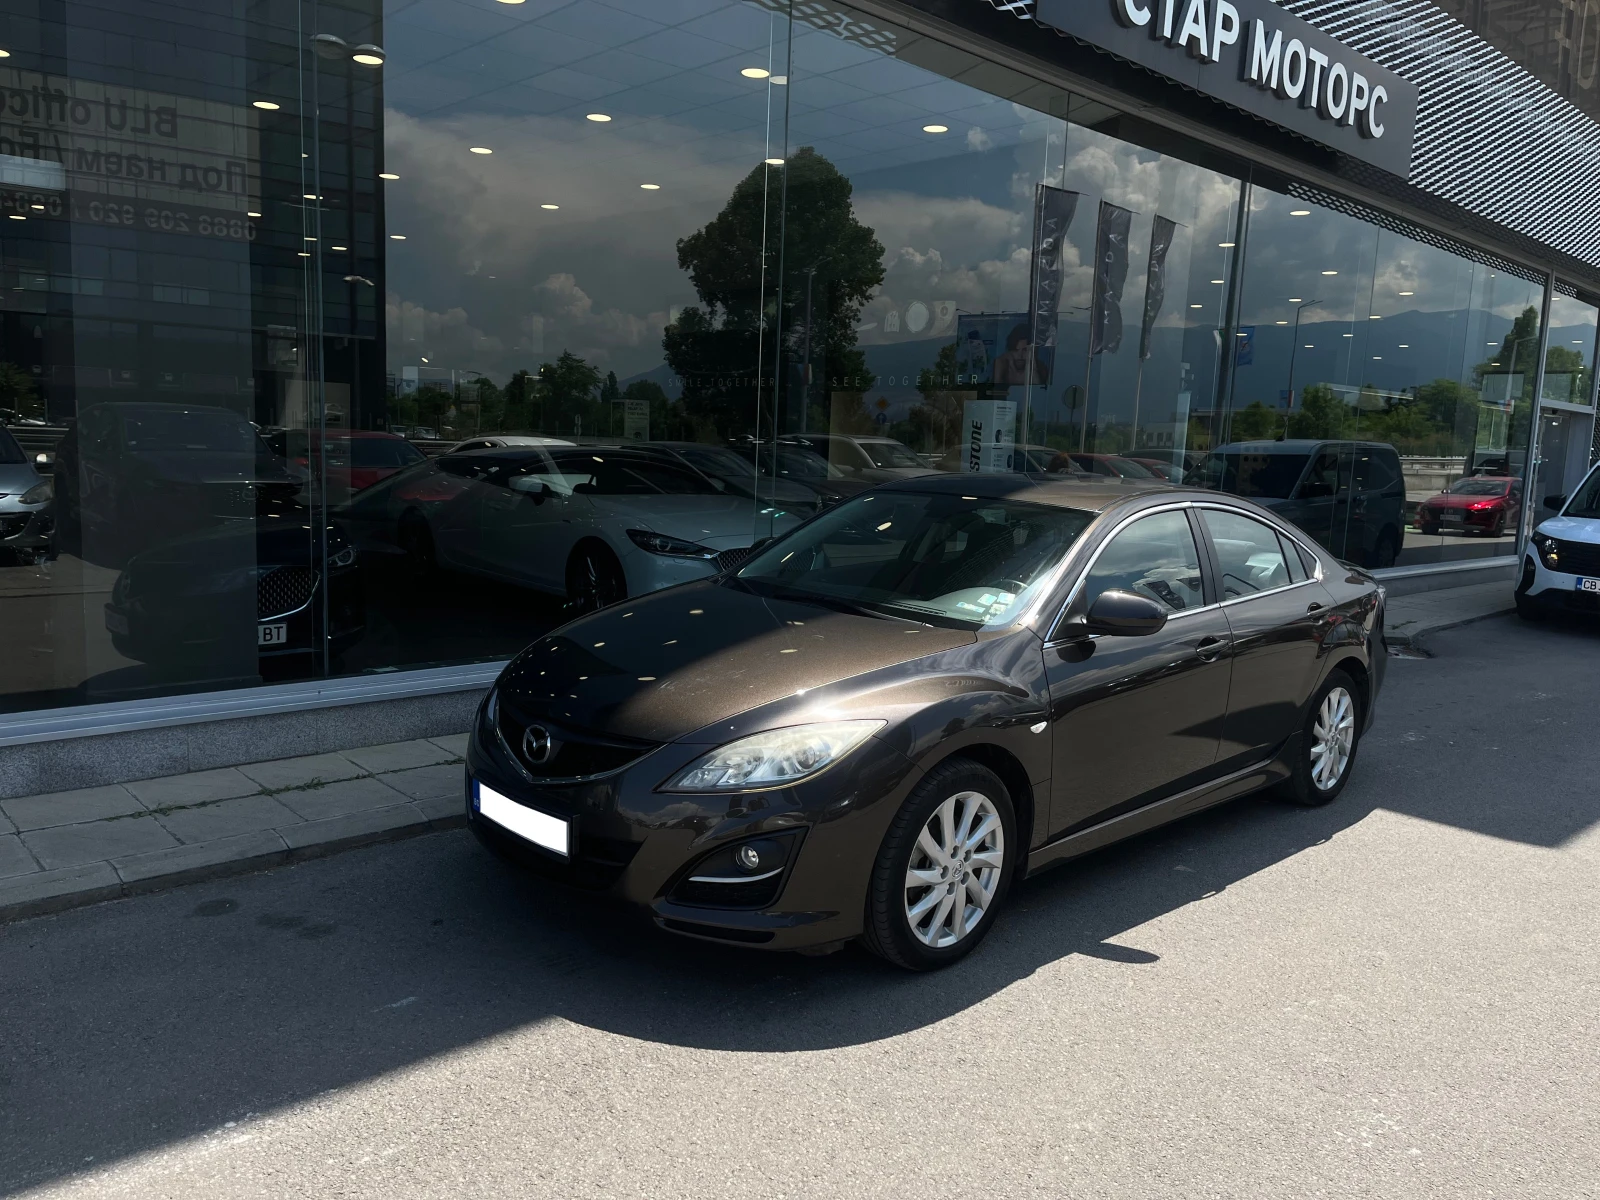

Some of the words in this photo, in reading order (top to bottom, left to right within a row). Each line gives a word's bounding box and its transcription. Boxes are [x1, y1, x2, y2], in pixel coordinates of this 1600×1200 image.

[1247, 18, 1389, 139] МОТОРС
[710, 376, 777, 388] TOGETHER
[832, 376, 861, 387] SEE
[876, 374, 978, 387] TOGETHER
[969, 419, 983, 473] STONE
[1583, 580, 1597, 590] CB
[263, 626, 284, 642] BT
